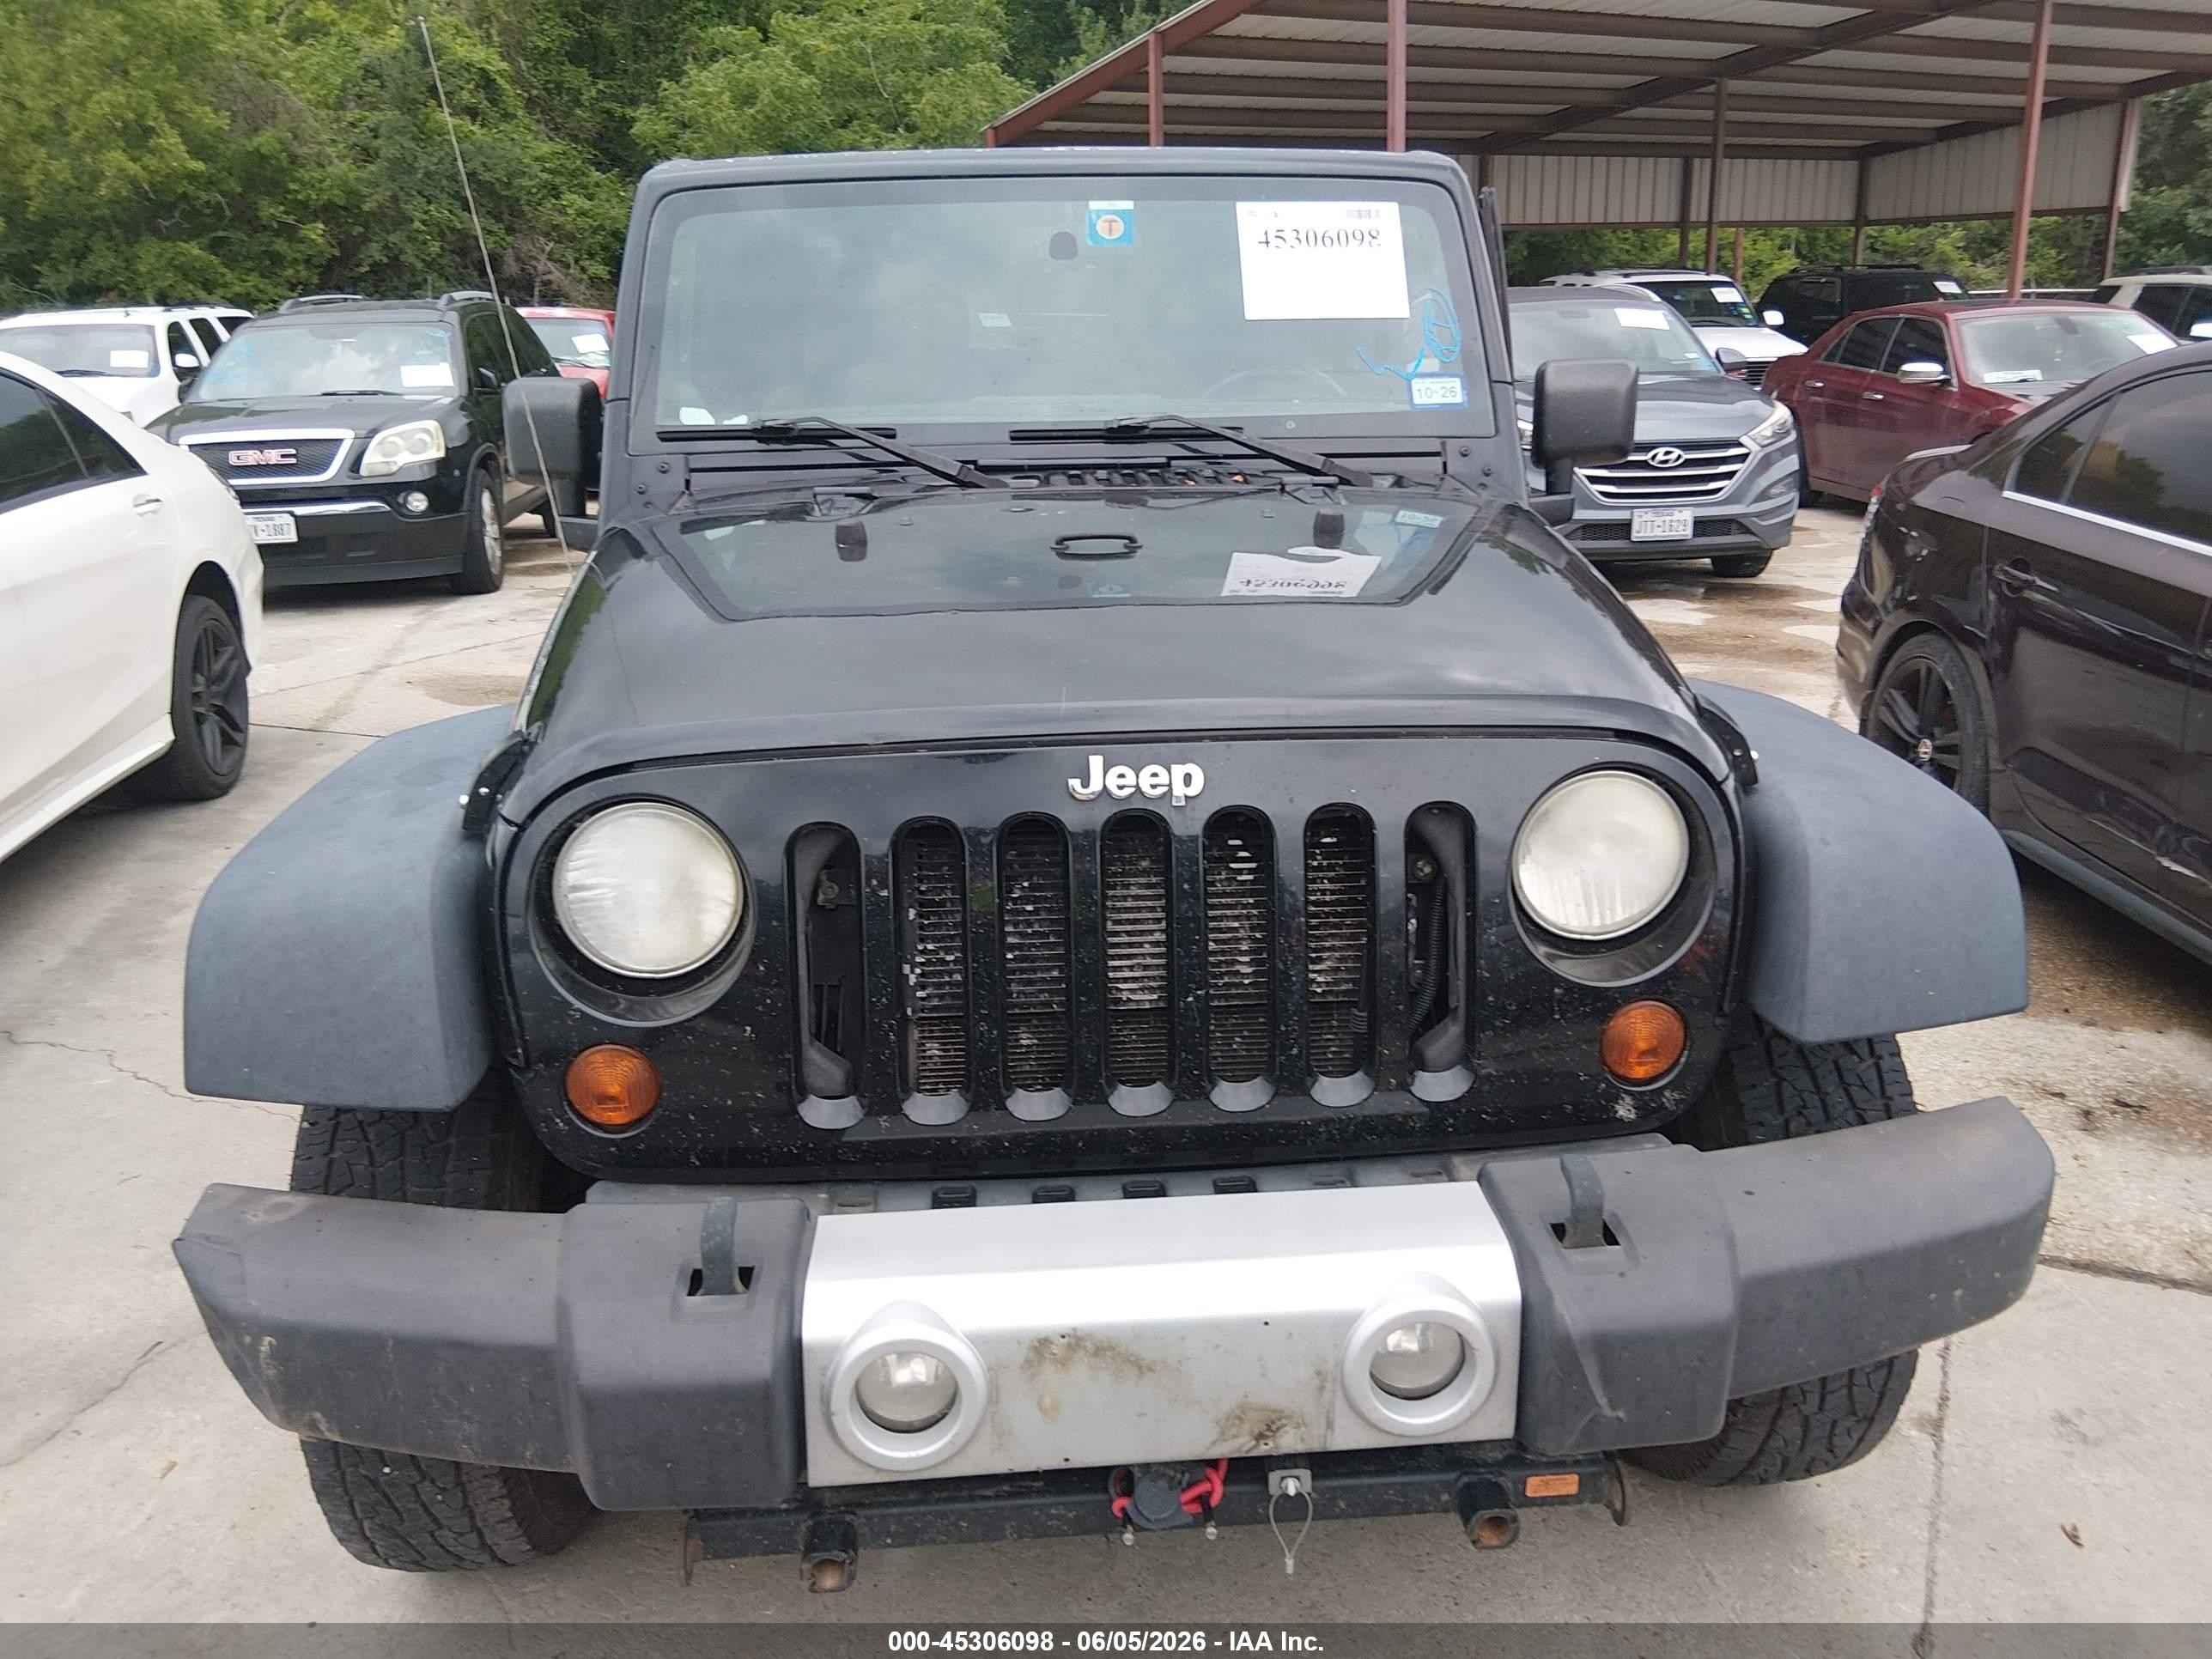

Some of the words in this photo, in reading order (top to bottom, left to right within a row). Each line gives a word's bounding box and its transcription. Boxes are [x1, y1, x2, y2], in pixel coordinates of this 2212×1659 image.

[1258, 228, 1381, 249] 45306098
[228, 449, 297, 466] GMC
[1067, 755, 1205, 806] Jeep
